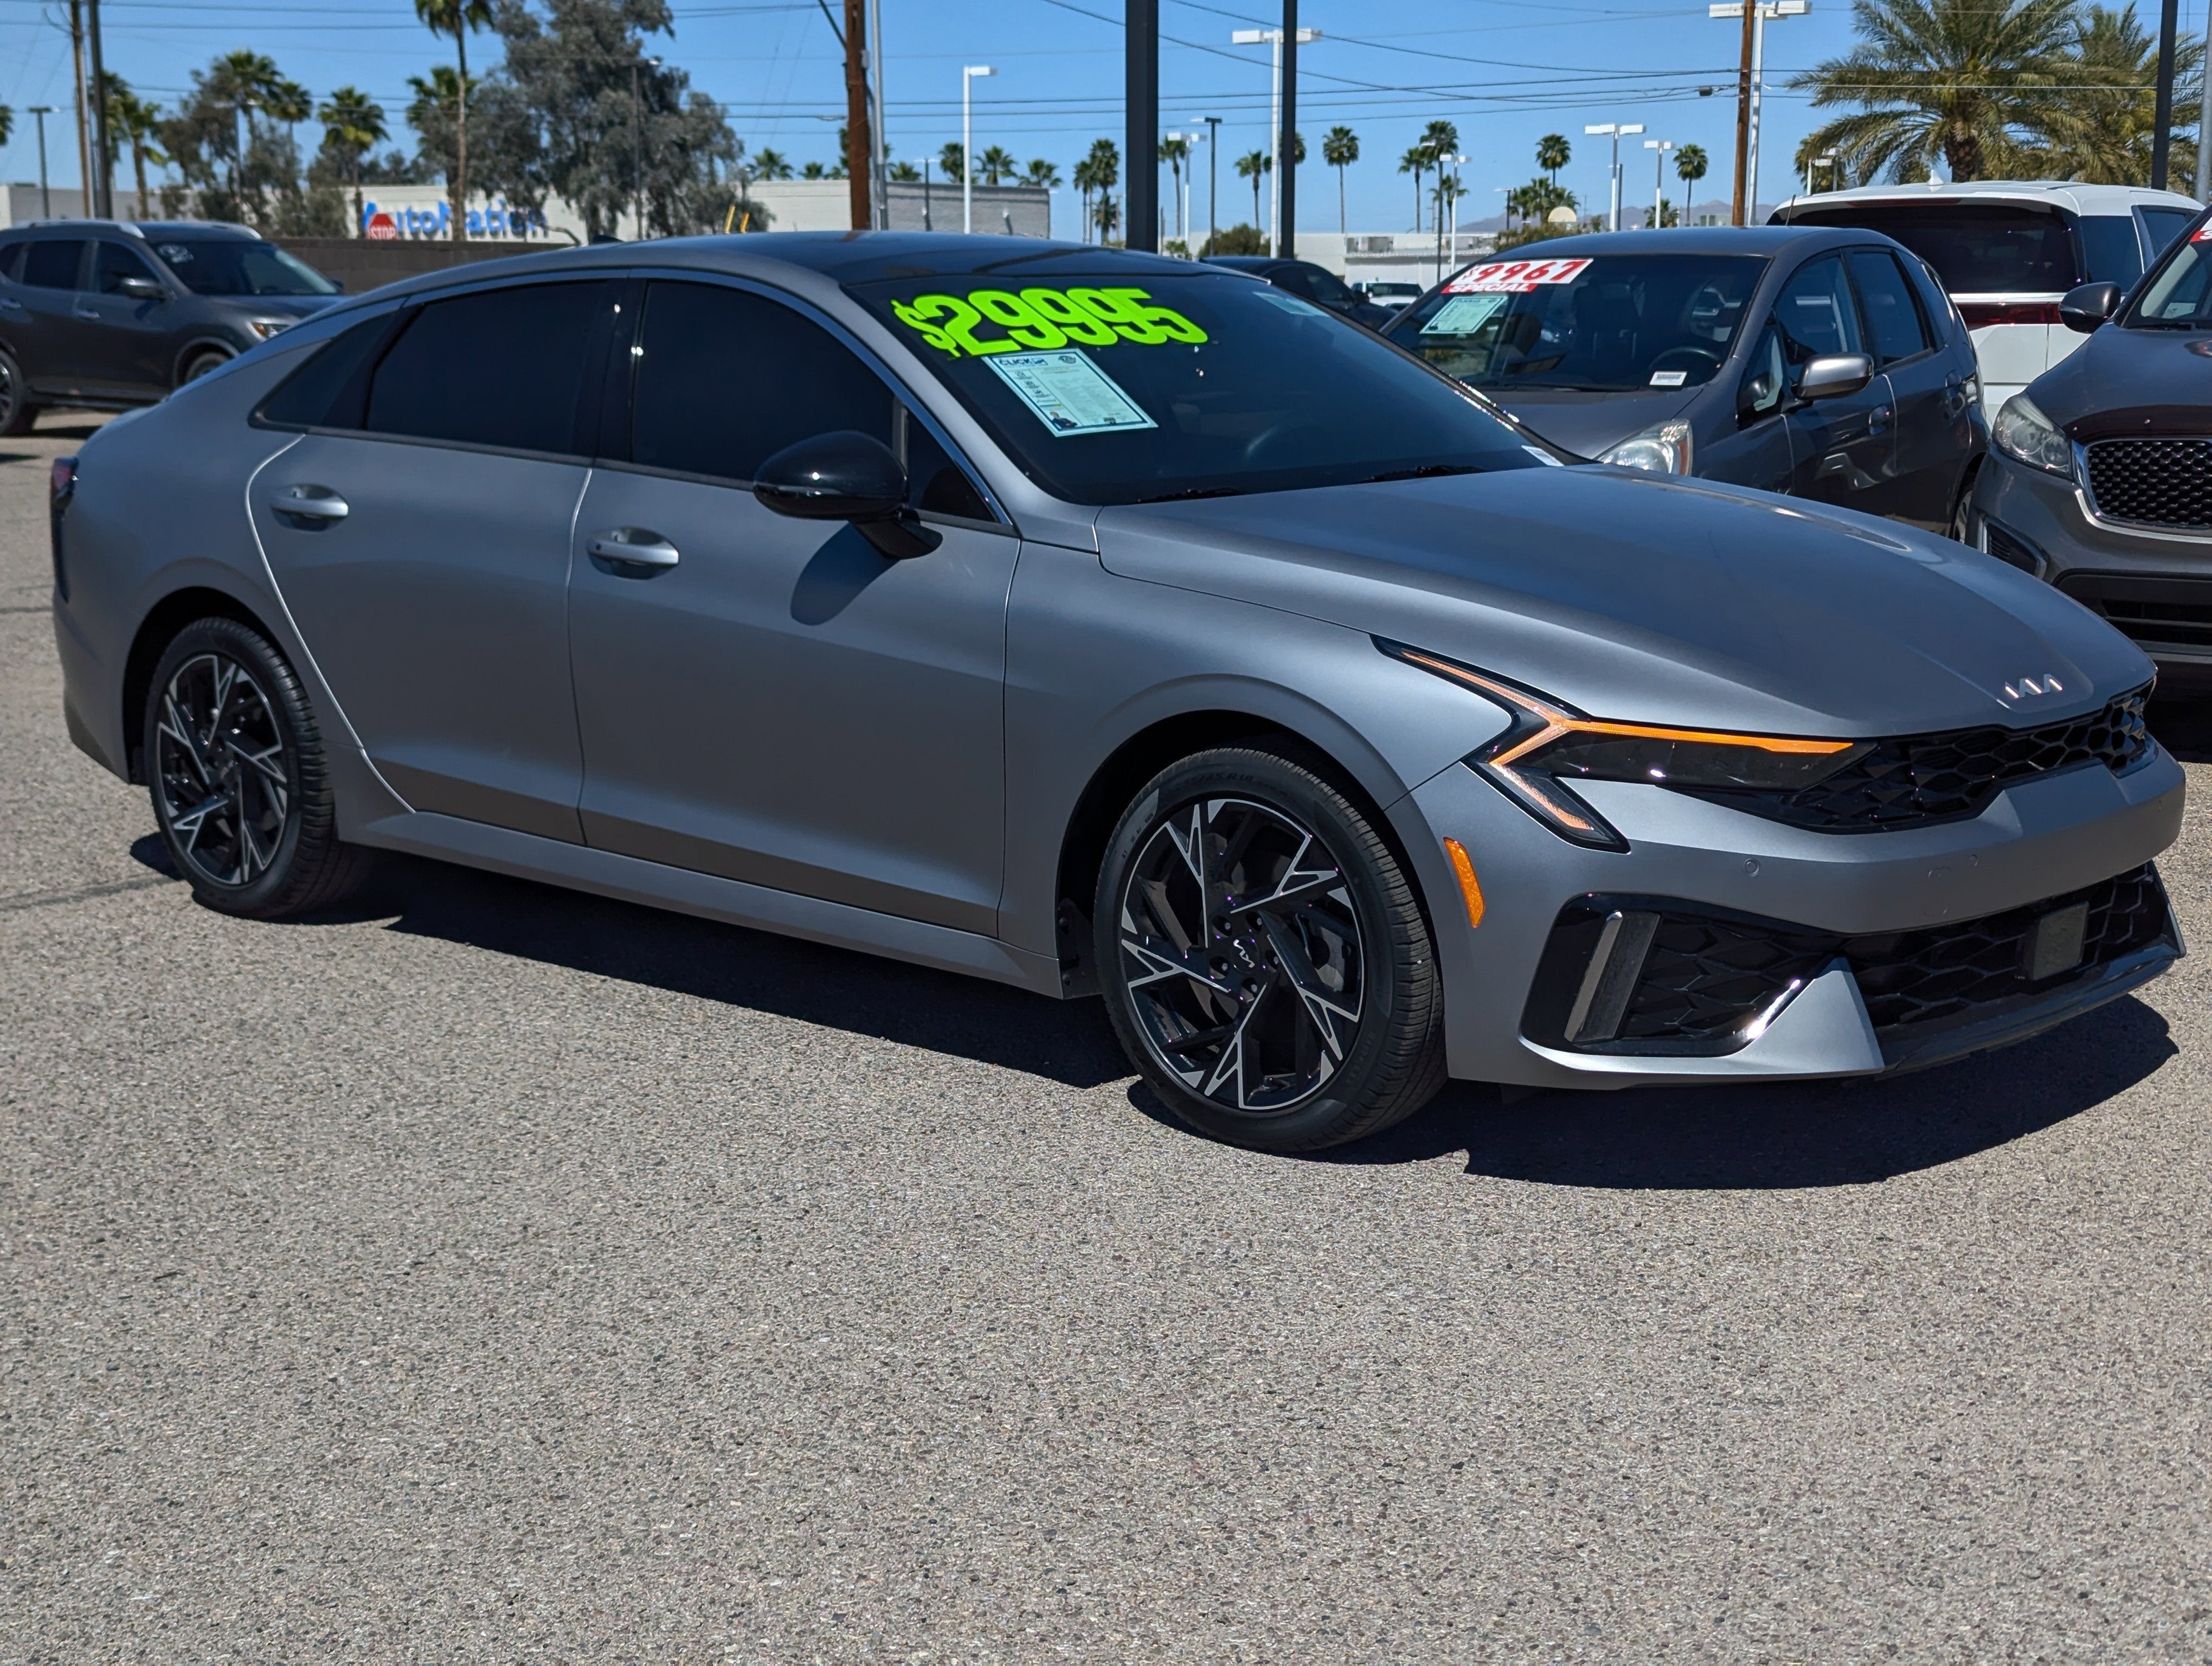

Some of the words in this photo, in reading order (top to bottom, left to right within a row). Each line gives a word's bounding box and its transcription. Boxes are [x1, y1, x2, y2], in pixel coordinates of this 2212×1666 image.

[1449, 283, 1530, 292] SPECIAL
[891, 289, 1208, 357] $29995
[2005, 673, 2062, 699] KIA
